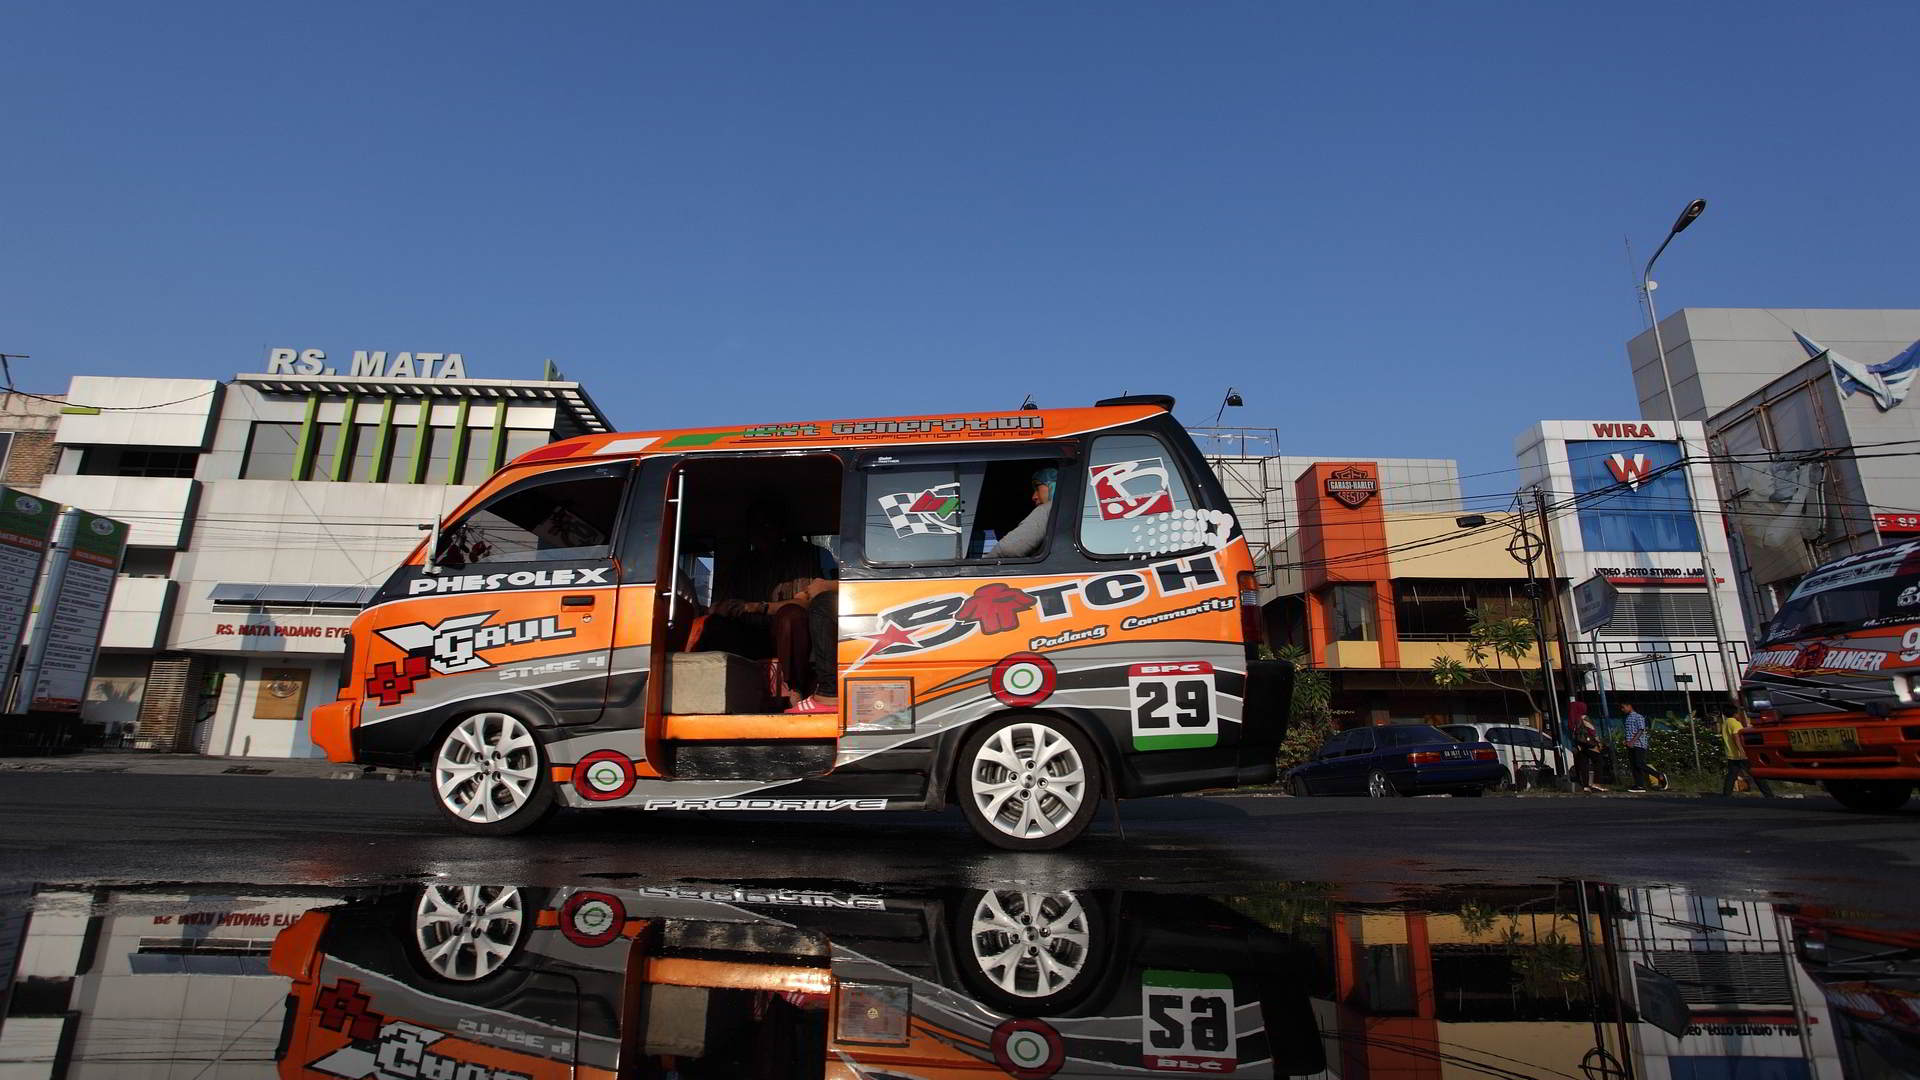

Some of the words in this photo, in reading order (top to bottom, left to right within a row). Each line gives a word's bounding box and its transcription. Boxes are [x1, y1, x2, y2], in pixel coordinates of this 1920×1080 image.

[267, 347, 337, 376] RS.
[350, 350, 468, 380] MATA
[1592, 423, 1656, 438] WIRA
[408, 567, 610, 595] PHESOLEX
[1625, 567, 1648, 576] FOTO
[1650, 567, 1682, 576] STUDIO
[1122, 598, 1236, 630] Community
[216, 623, 235, 635] RS.
[238, 624, 271, 637] MATA
[273, 625, 322, 637] PADANG
[1031, 625, 1107, 650] Padang
[1140, 664, 1201, 674] BPC
[1821, 650, 1887, 671] RANGER
[1136, 680, 1210, 729] 29
[644, 798, 889, 811] PRODRIVE
